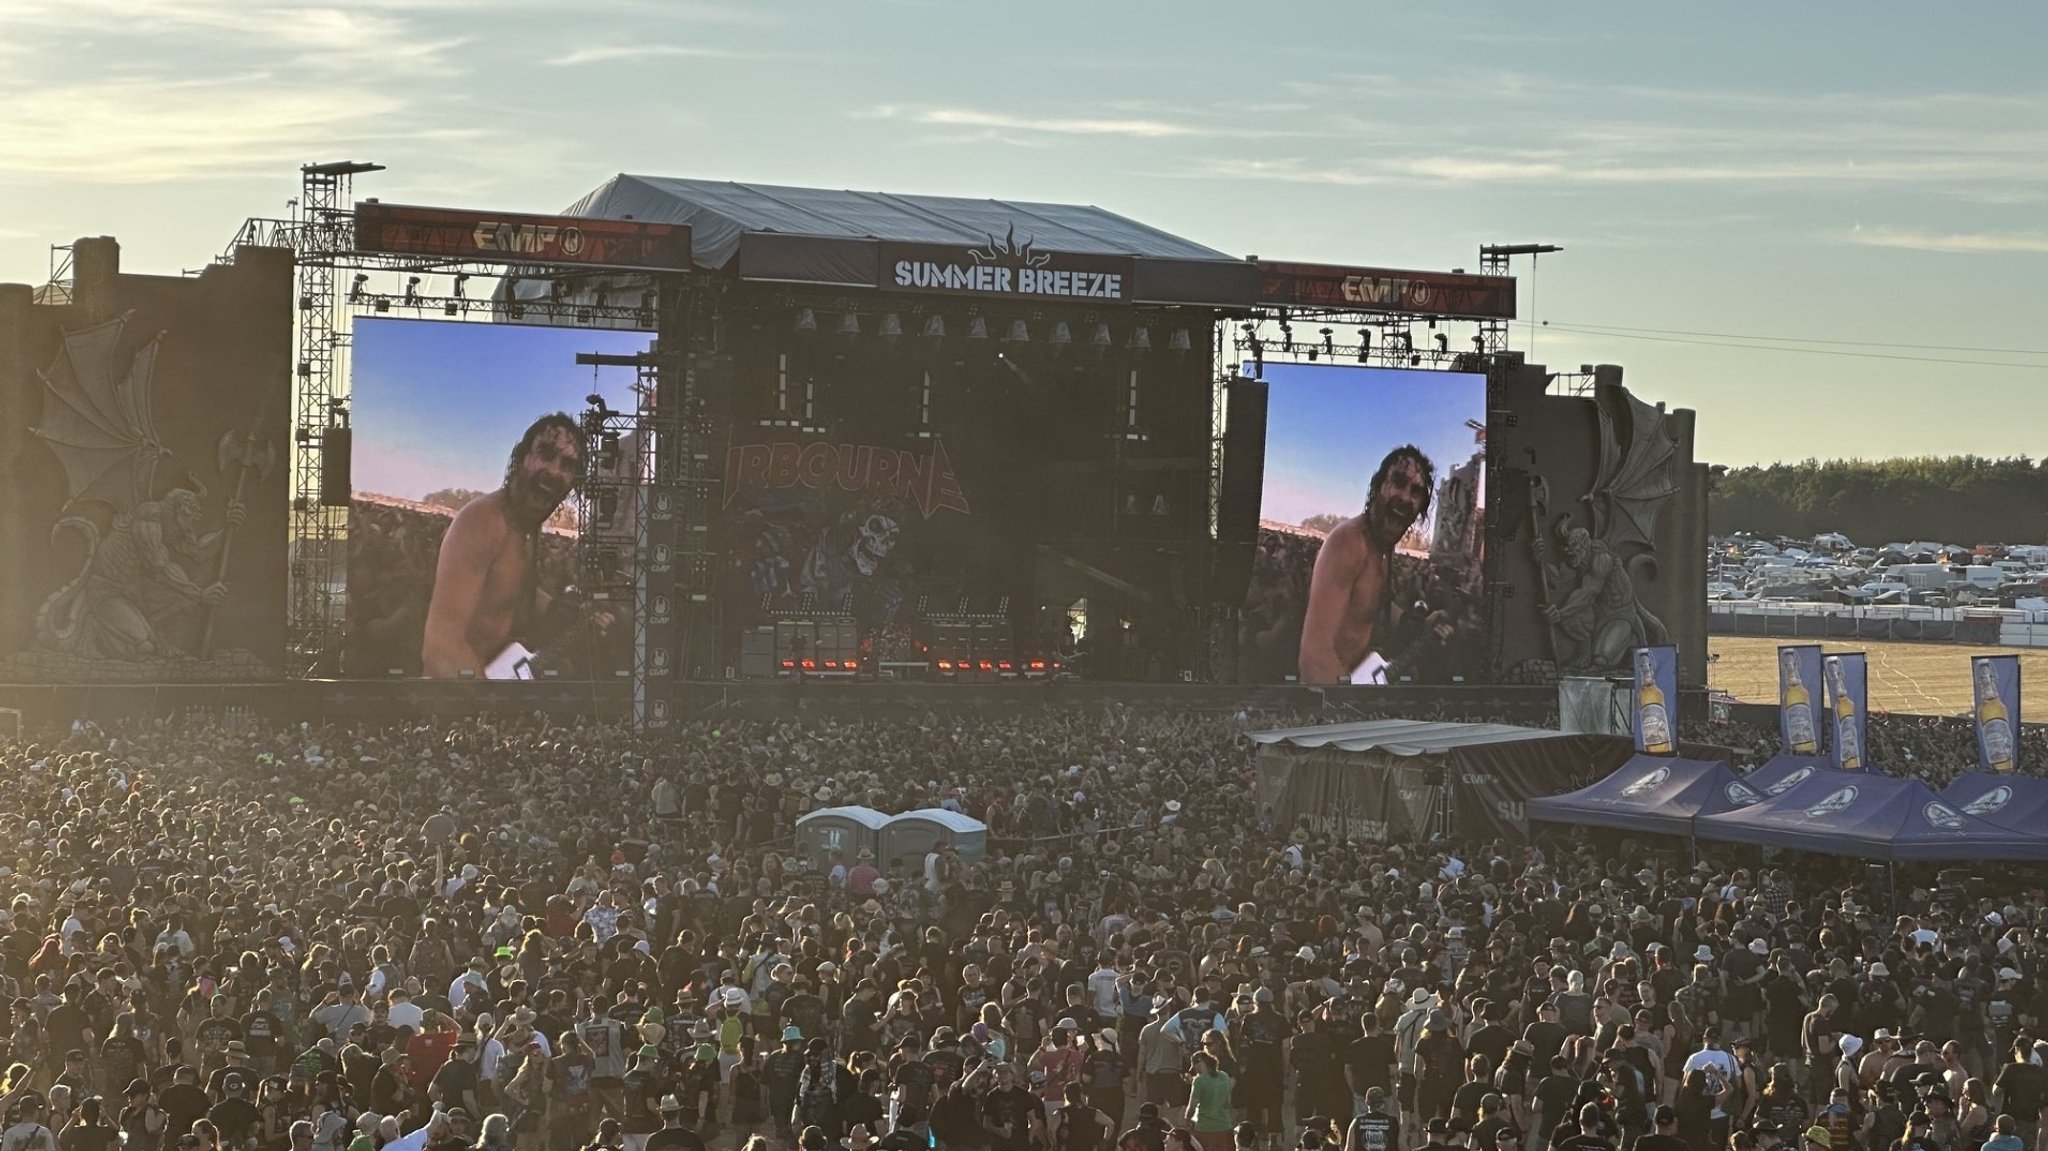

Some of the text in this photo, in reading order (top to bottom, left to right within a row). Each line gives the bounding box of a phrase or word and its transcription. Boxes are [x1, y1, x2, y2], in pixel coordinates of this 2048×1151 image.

[473, 221, 558, 252] EMP
[895, 260, 1121, 298] SUMMER BREEZE
[1341, 275, 1409, 303] EMP
[722, 436, 971, 519] IRBOURNE
